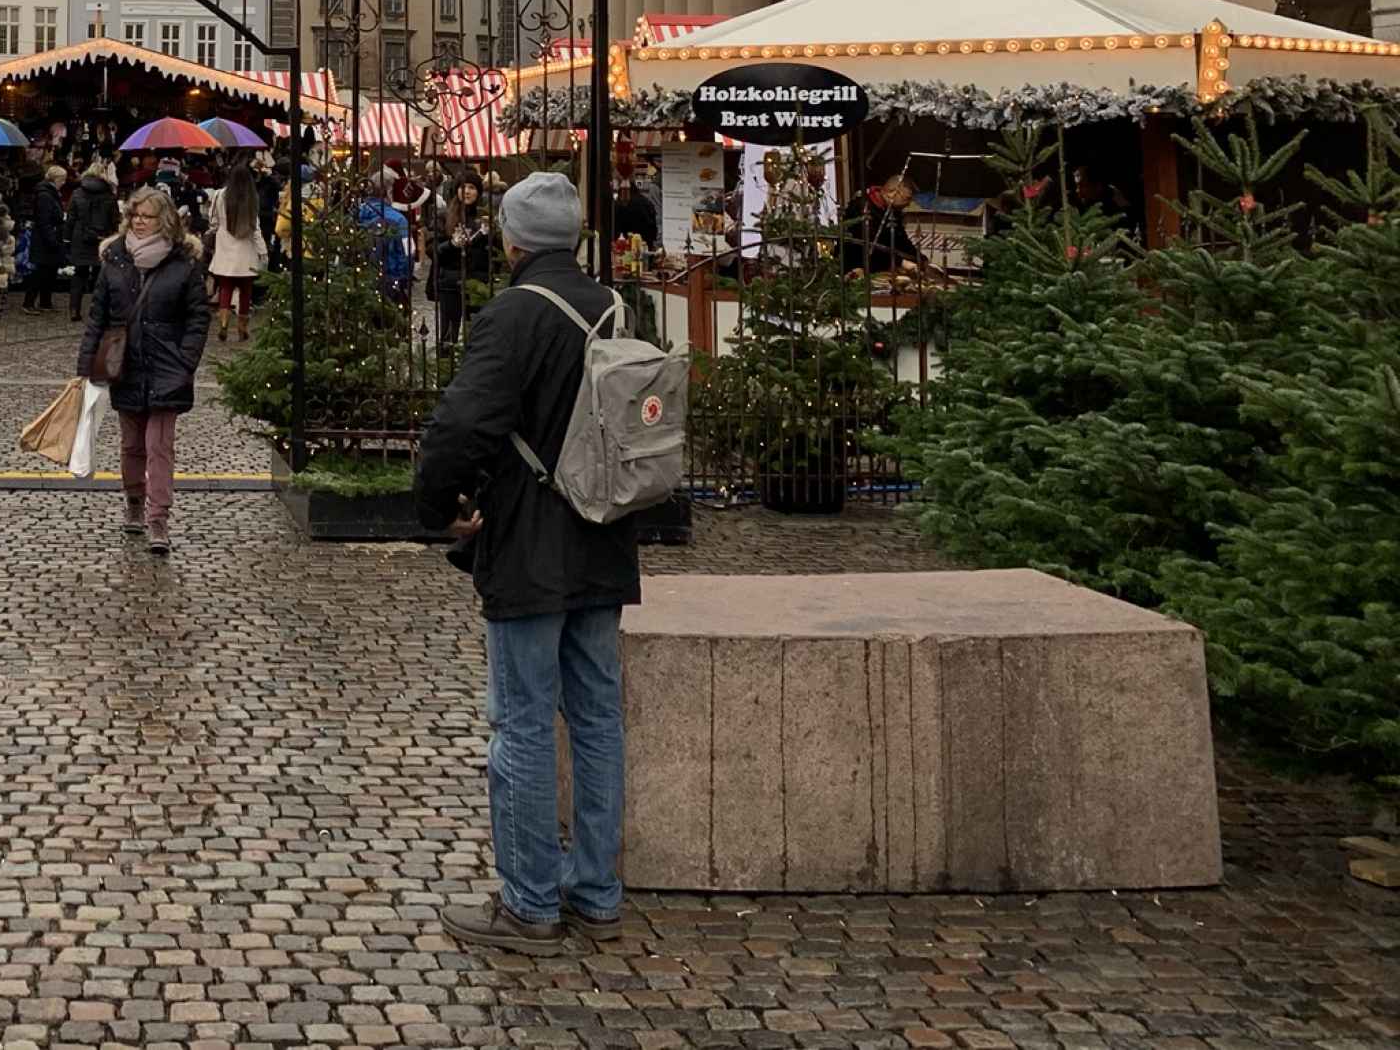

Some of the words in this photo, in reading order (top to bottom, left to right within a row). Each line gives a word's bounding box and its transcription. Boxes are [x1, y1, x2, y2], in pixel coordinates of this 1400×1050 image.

[699, 85, 858, 105] Holzkohlegrill
[720, 111, 770, 127] Brat
[774, 111, 844, 128] Wurst
